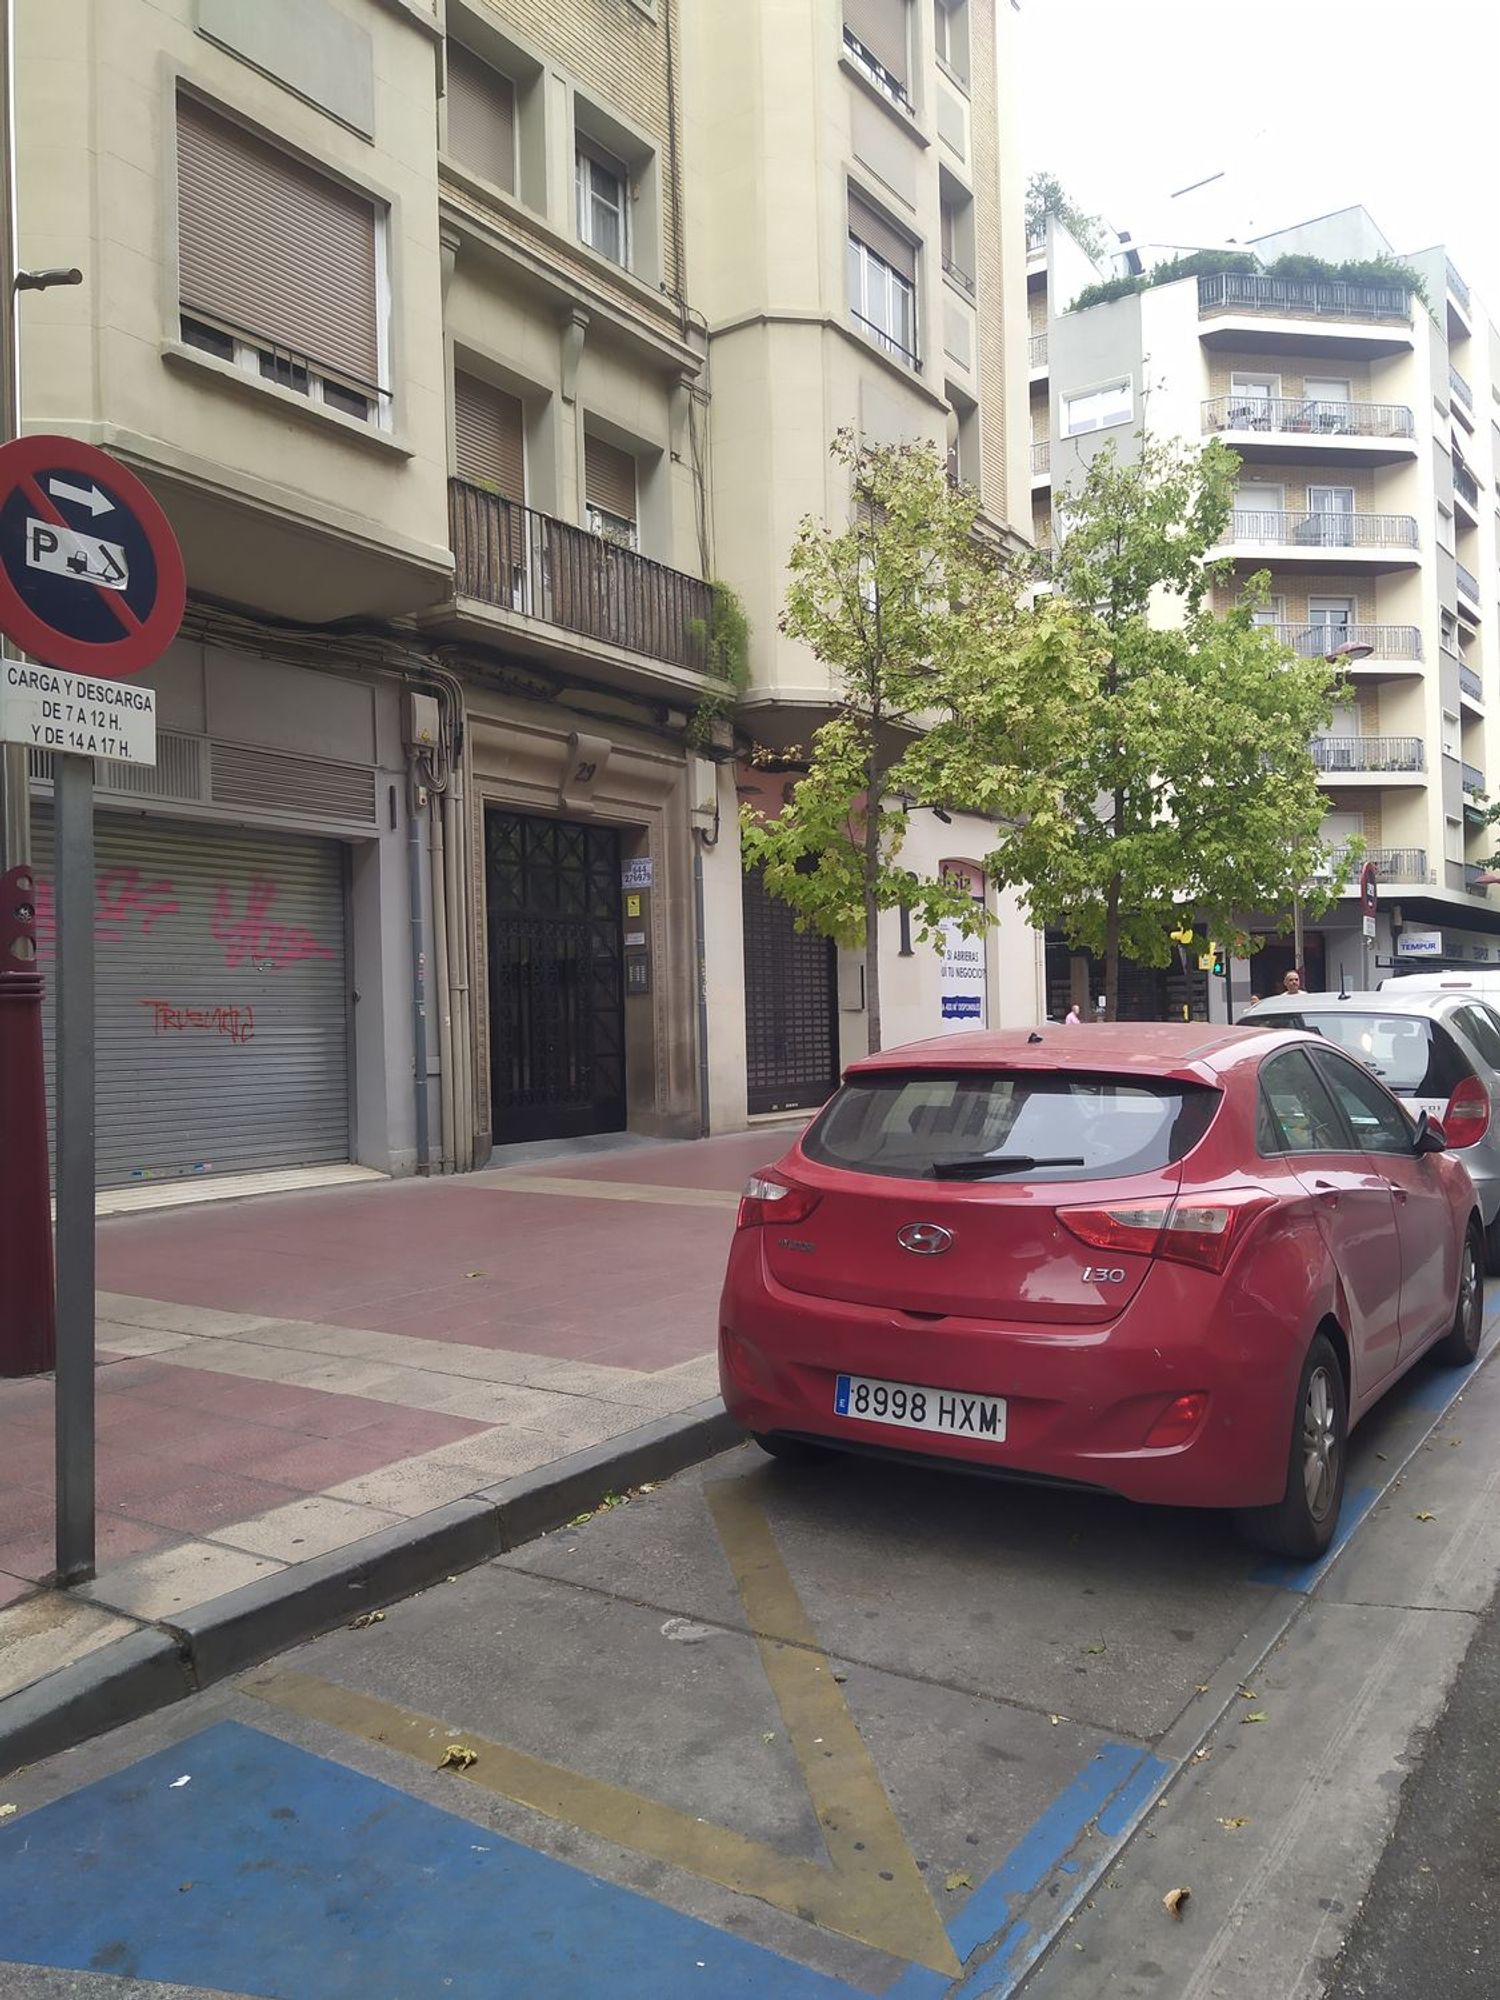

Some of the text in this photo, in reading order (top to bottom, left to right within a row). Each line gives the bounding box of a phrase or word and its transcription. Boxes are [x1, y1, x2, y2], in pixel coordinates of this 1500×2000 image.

[33, 527, 58, 562] P
[7, 667, 153, 712] CARGA Y DESCARGA
[42, 700, 122, 731] DE 7 A 12 H.
[31, 724, 132, 758] Y DE 14 A 17 H.
[575, 762, 597, 783] 29
[1400, 942, 1436, 951] TEMPUR
[1081, 1265, 1126, 1284] i30
[854, 1384, 926, 1423] 8998
[938, 1396, 998, 1435] HXM
